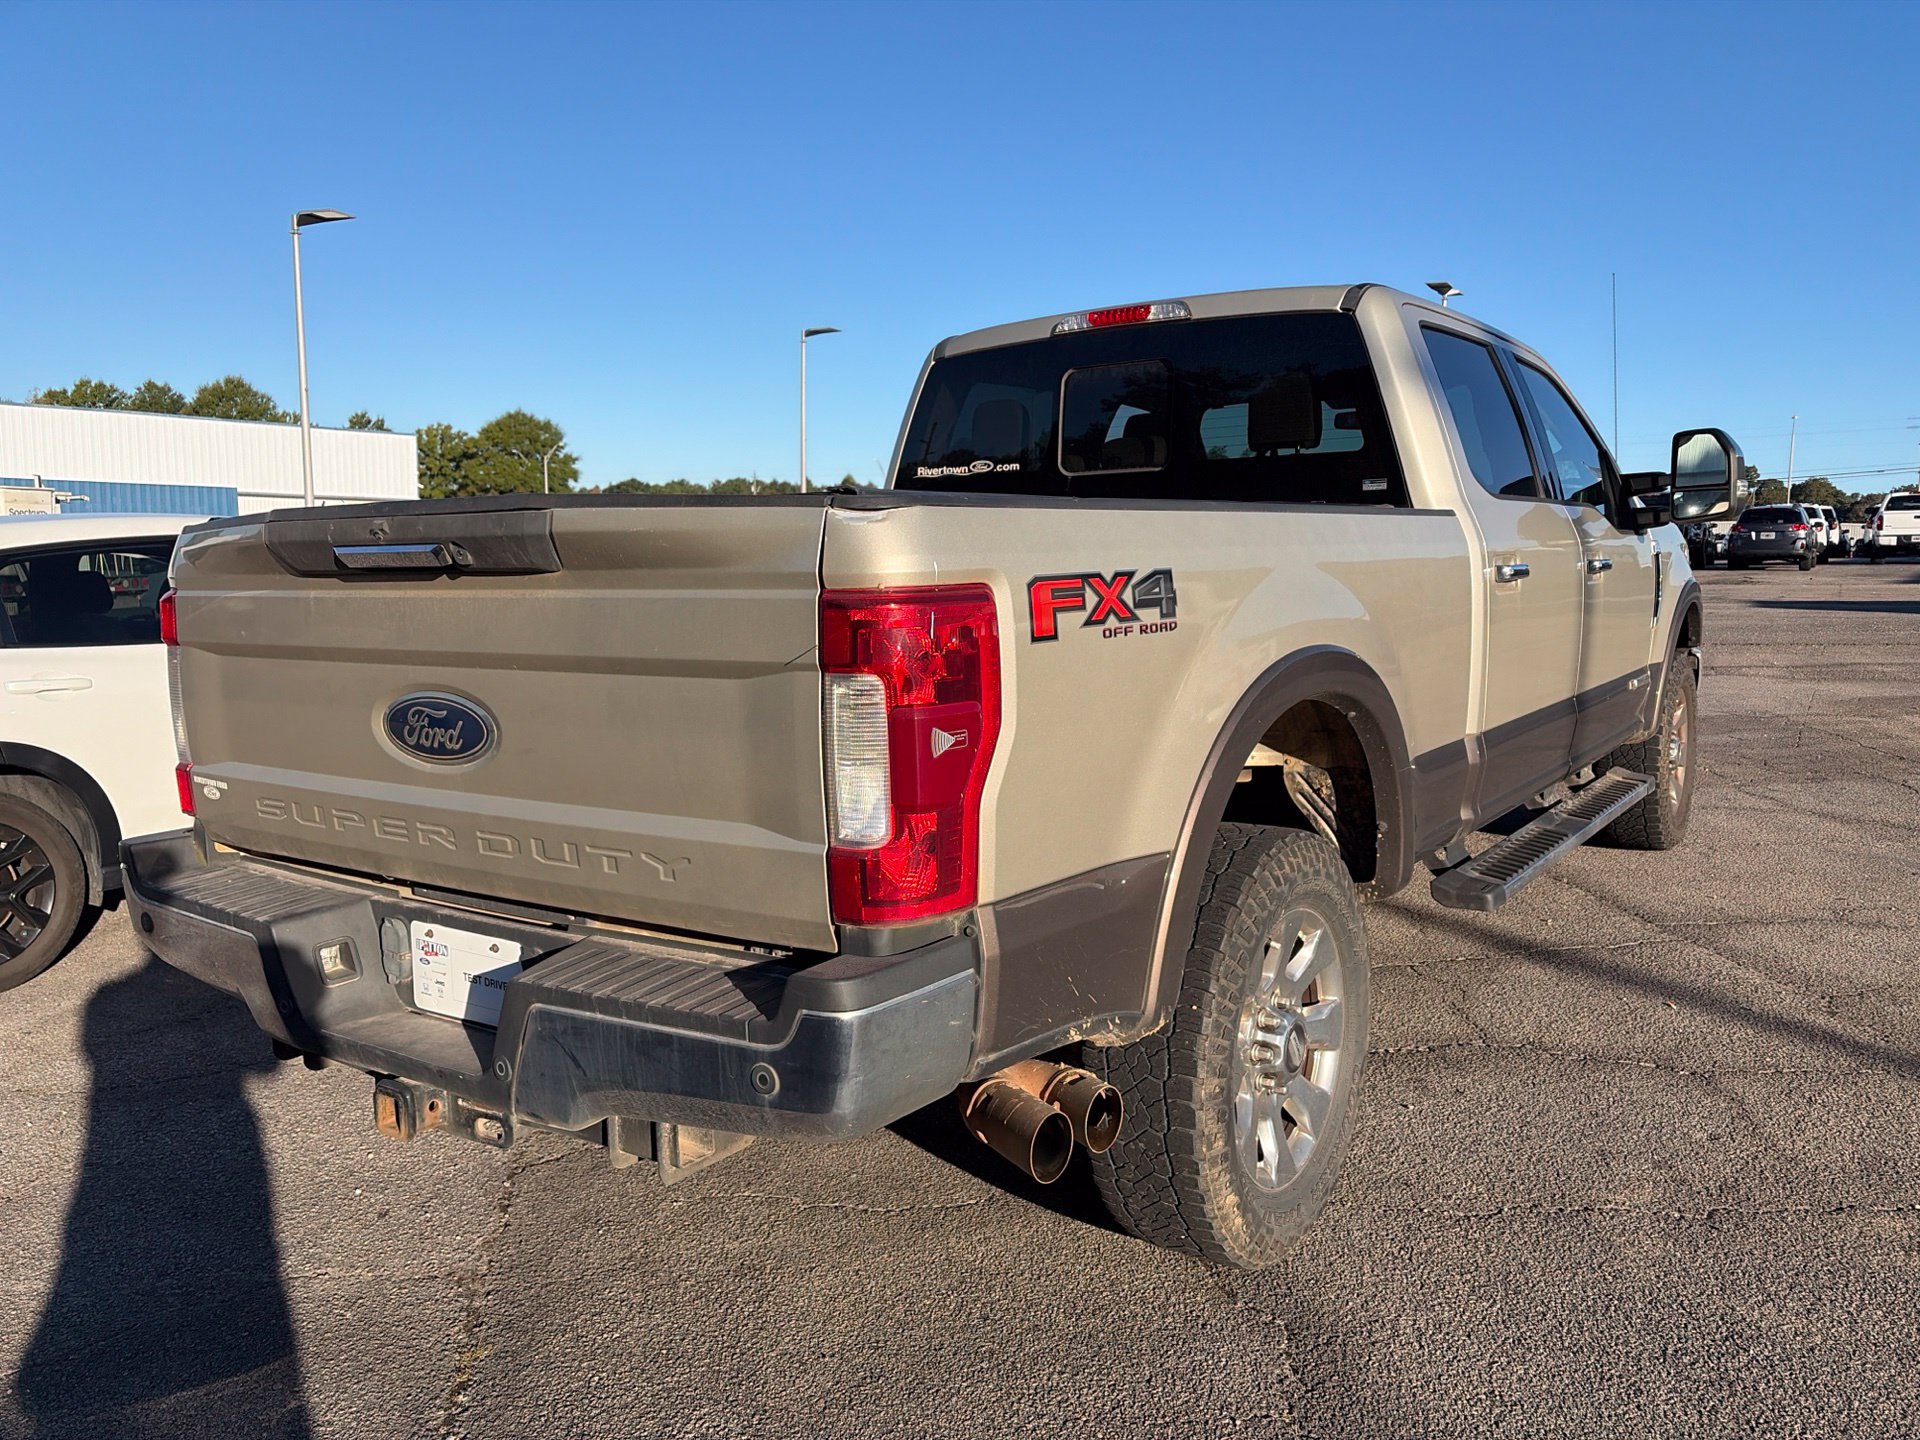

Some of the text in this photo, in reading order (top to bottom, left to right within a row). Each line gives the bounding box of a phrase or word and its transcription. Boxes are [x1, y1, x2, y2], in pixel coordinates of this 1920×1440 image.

[917, 466, 969, 476] Rivertown
[993, 463, 1020, 472] .com
[1026, 568, 1178, 645] FX4
[1102, 620, 1178, 640] OFF ROAD
[403, 706, 463, 750] Ford
[255, 797, 692, 883] SUPER DUTY
[463, 971, 482, 986] TEST
